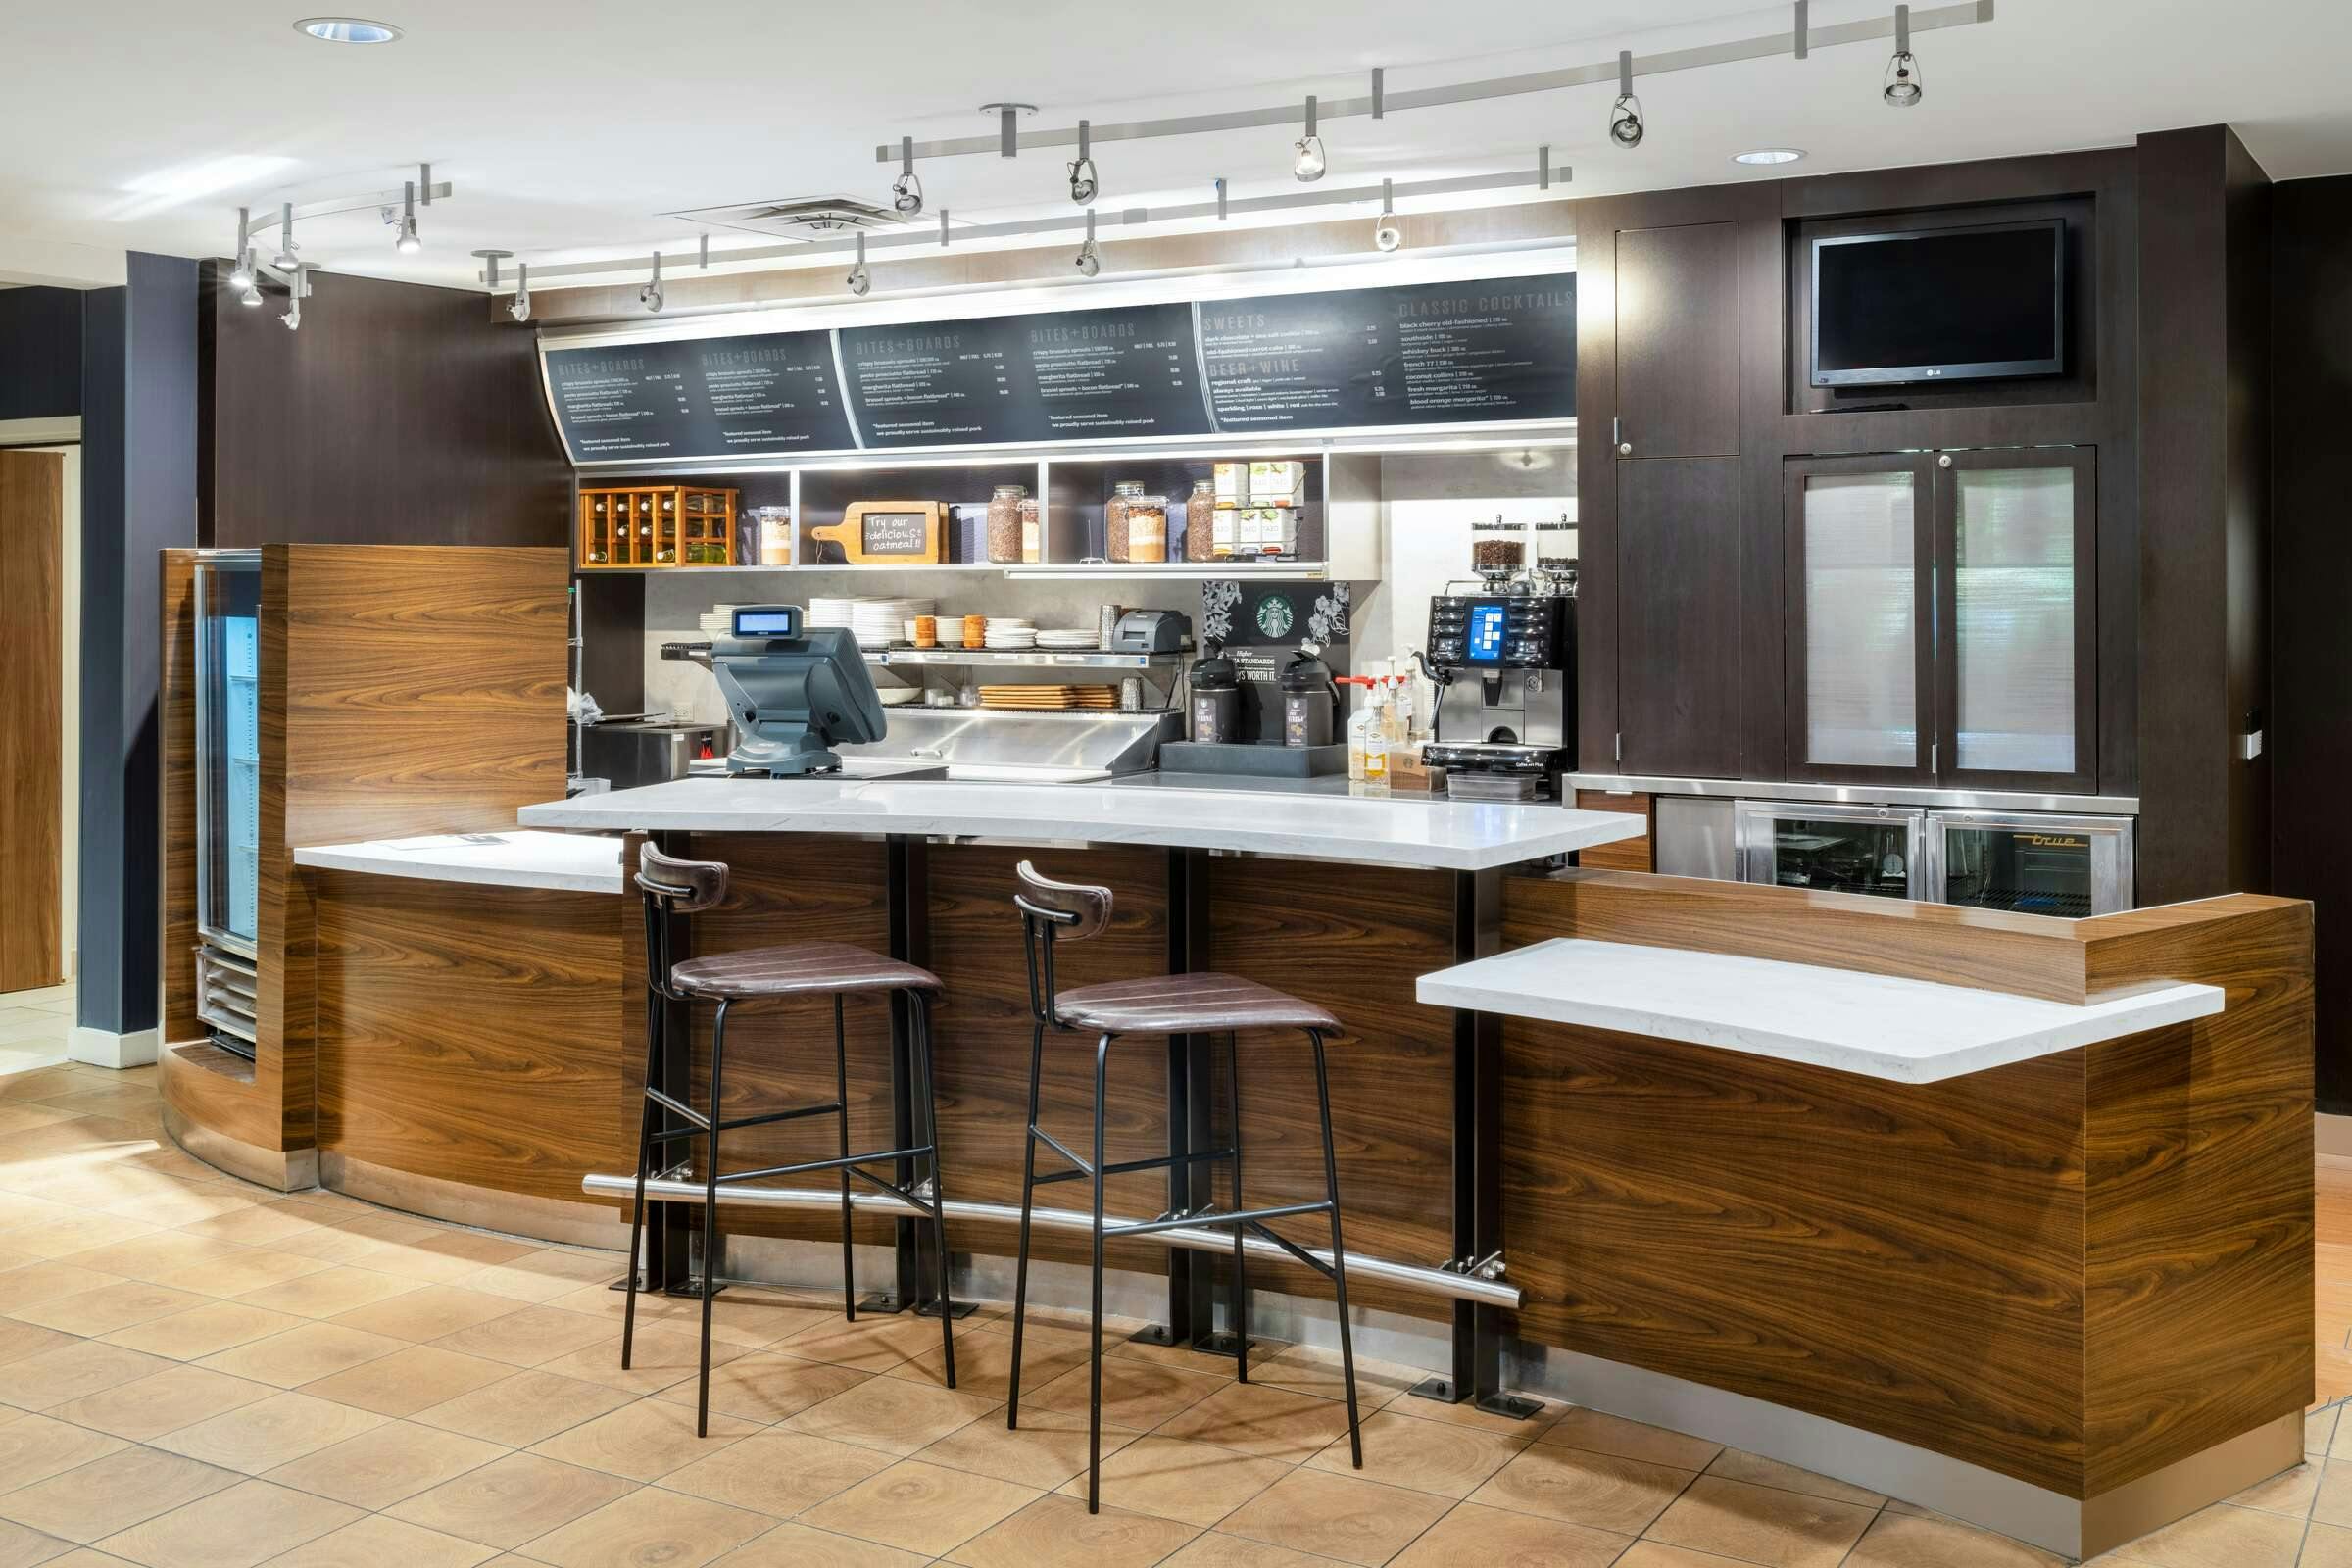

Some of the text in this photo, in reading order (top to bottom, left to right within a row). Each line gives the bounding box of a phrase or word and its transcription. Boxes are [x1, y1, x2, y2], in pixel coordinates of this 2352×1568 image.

[1399, 291, 1572, 317] CLASSIC COCKTAILS
[1205, 314, 1265, 331] SWEETS
[1441, 318, 1487, 326] old-fashioned
[1031, 323, 1135, 343] BITES+BOARDS
[856, 336, 960, 354] BITES+BOARDS
[868, 516, 908, 529] Try our
[870, 528, 917, 540] delicious
[1246, 671, 1268, 681] WORTH
